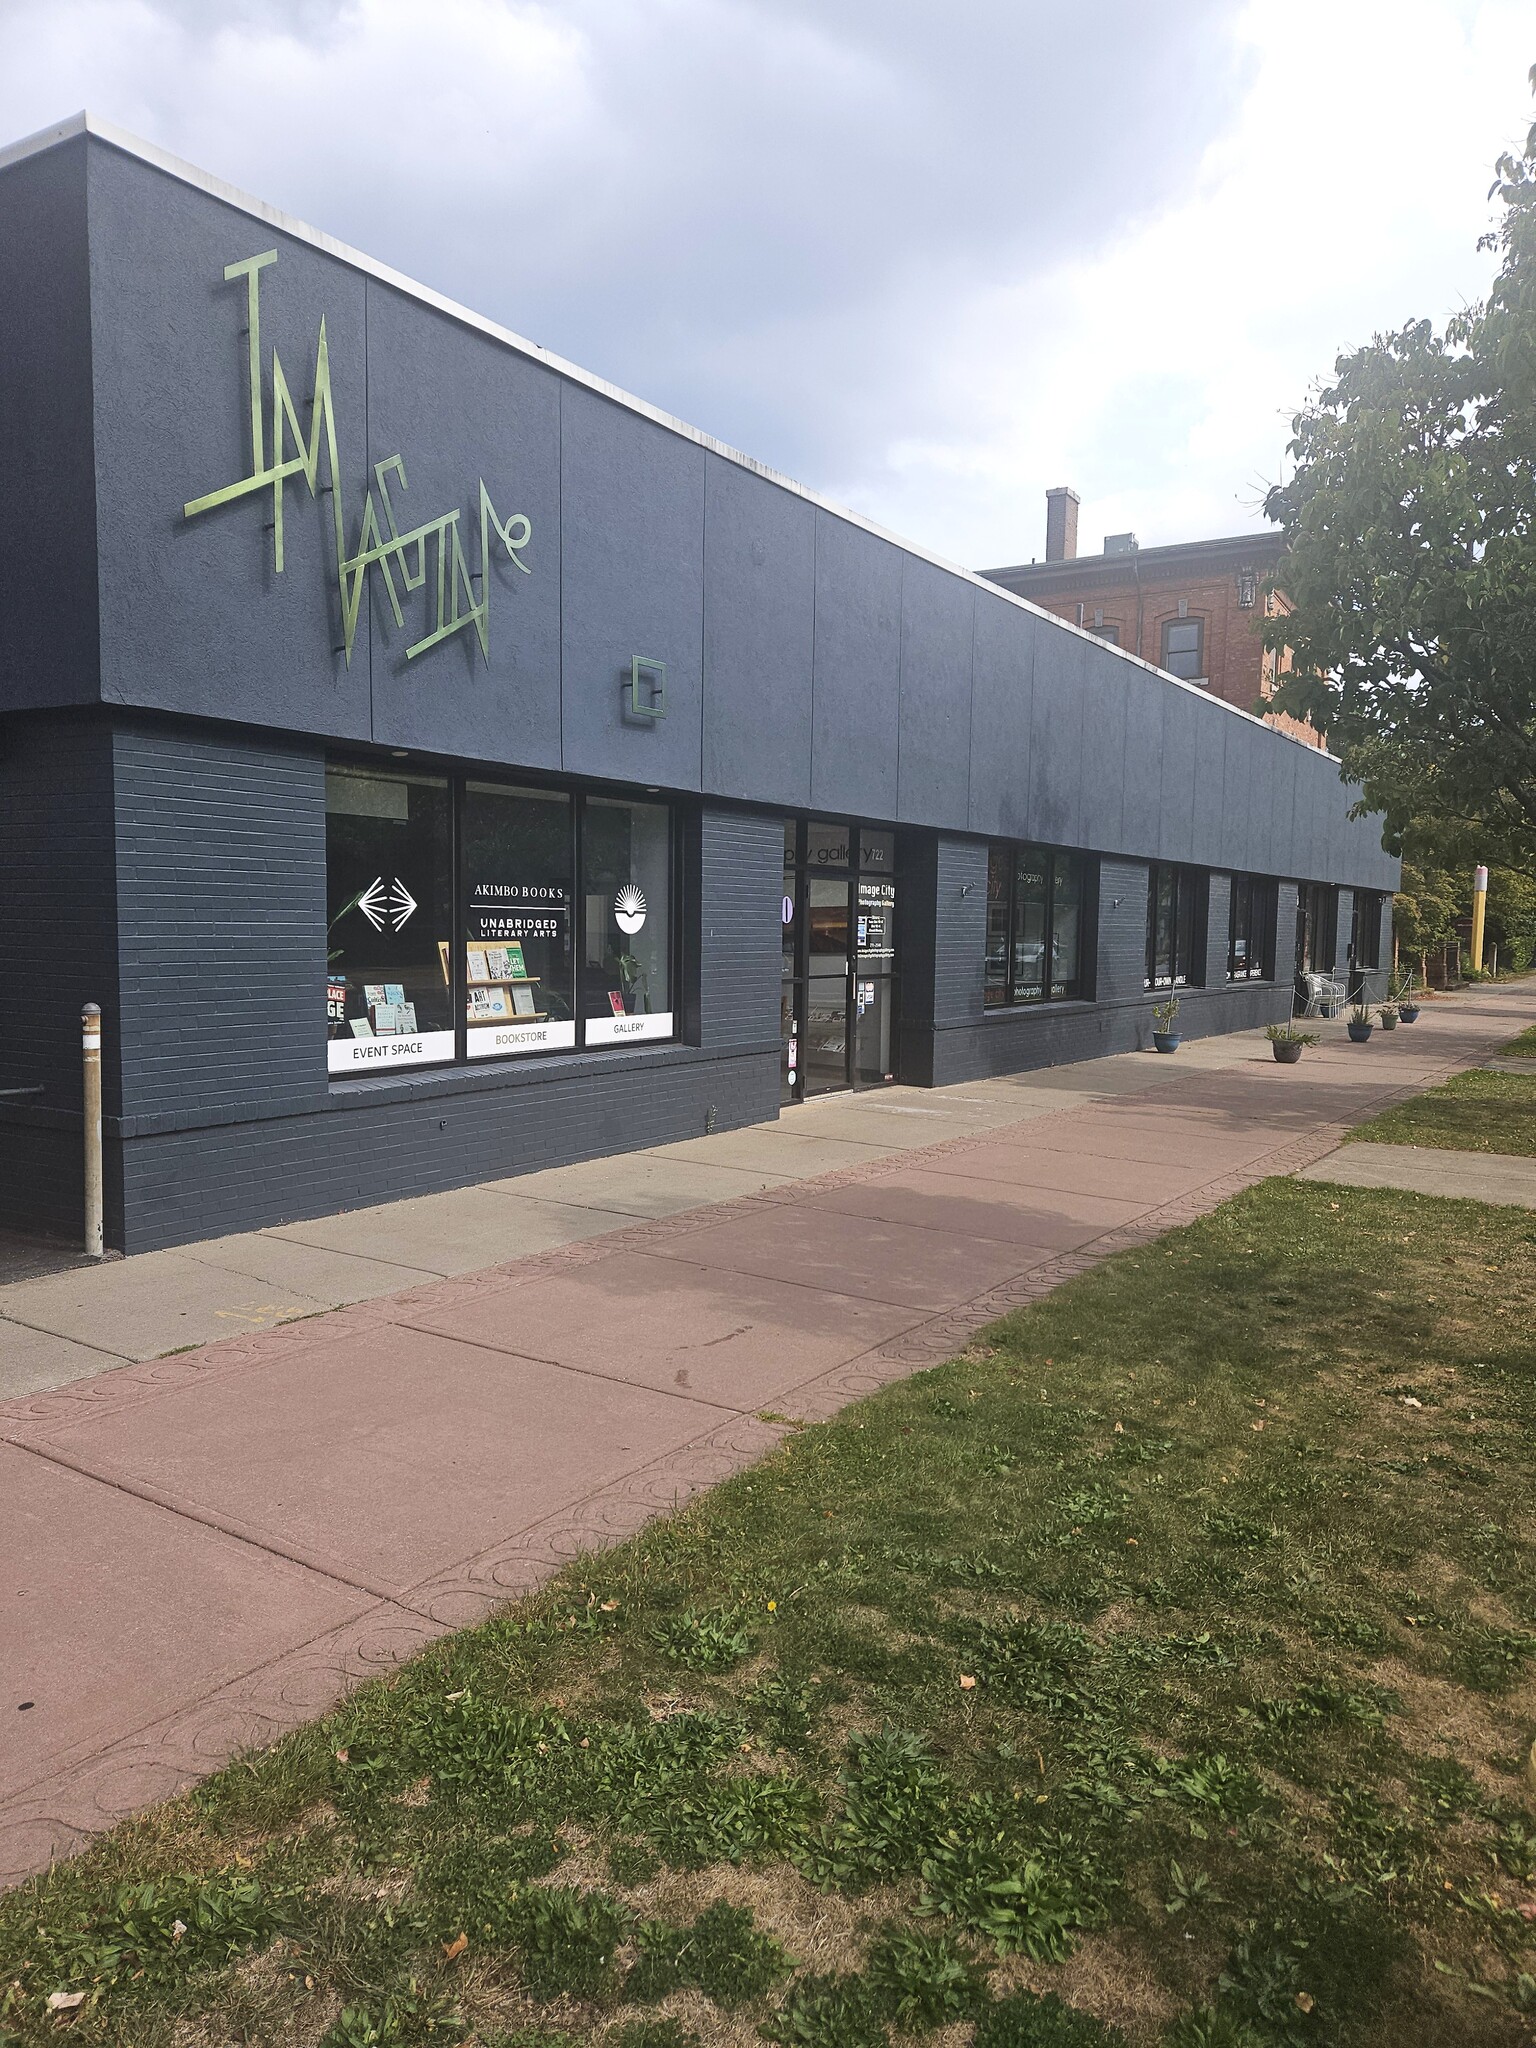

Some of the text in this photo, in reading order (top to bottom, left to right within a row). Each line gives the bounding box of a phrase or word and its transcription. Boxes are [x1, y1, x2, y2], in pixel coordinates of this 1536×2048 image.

[871, 848, 884, 860] 722
[474, 884, 564, 899] AKIMBO BOOKS
[858, 883, 895, 899] Image City
[480, 918, 557, 930] UNABRIDGED
[480, 929, 557, 938] LITERARY ARTS
[327, 988, 344, 1001] LACE
[614, 1022, 644, 1034] GALLERY
[495, 1031, 547, 1045] BOOKSTORE
[353, 1042, 422, 1059] EVENT SPACE
